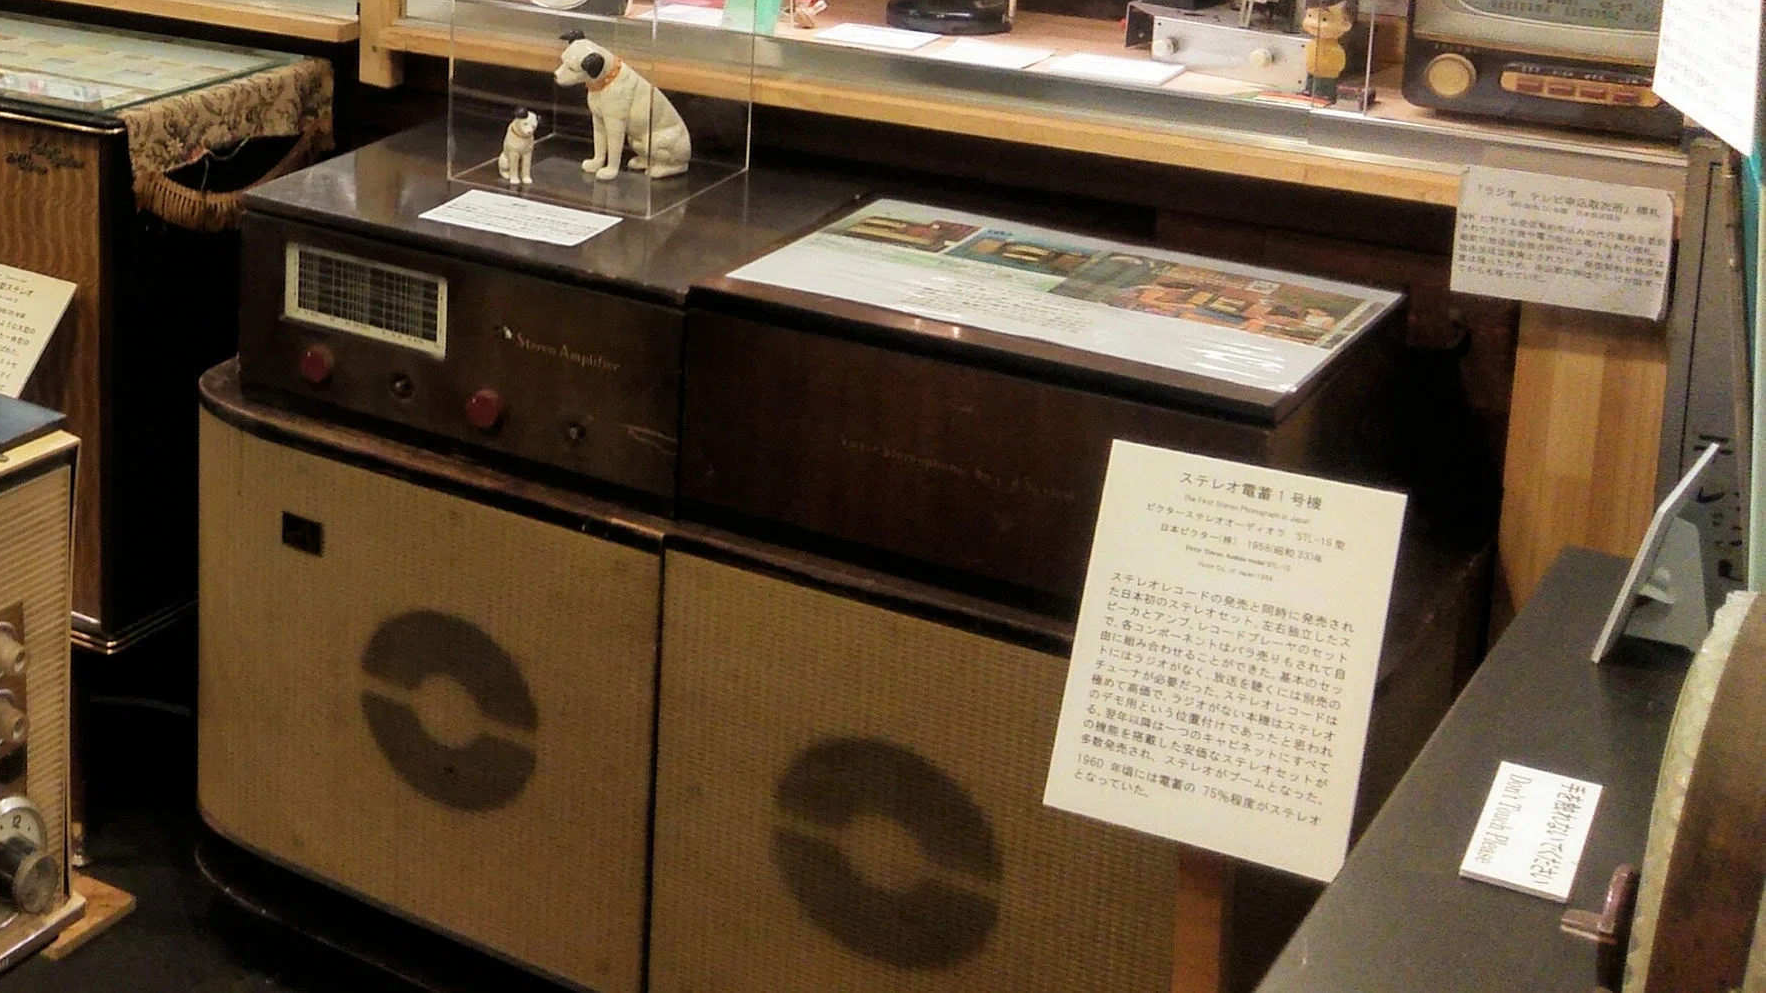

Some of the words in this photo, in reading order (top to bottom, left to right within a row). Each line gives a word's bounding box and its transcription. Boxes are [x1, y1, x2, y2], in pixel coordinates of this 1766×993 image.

[1104, 600, 1350, 665] ピーカとアンプ、レコードプレーヤのセット
[1110, 570, 1355, 634] ステレオレコードの発売と同時に発売され
[1101, 614, 1347, 680] で、各コンポーネントはバラ売りもされて自
[1087, 688, 1334, 758] のデモ用という位置付けであったと思われ
[1090, 673, 1337, 742] 極めて高価で、ラジオがない本機はステレオ
[1072, 768, 1150, 798] となっていた。
[1082, 718, 1329, 789] の機能を搭載した安価なステレオセットが
[1475, 831, 1509, 864] Please
[1488, 801, 1522, 831] Touch
[1530, 783, 1586, 886] 手を触れないでください
